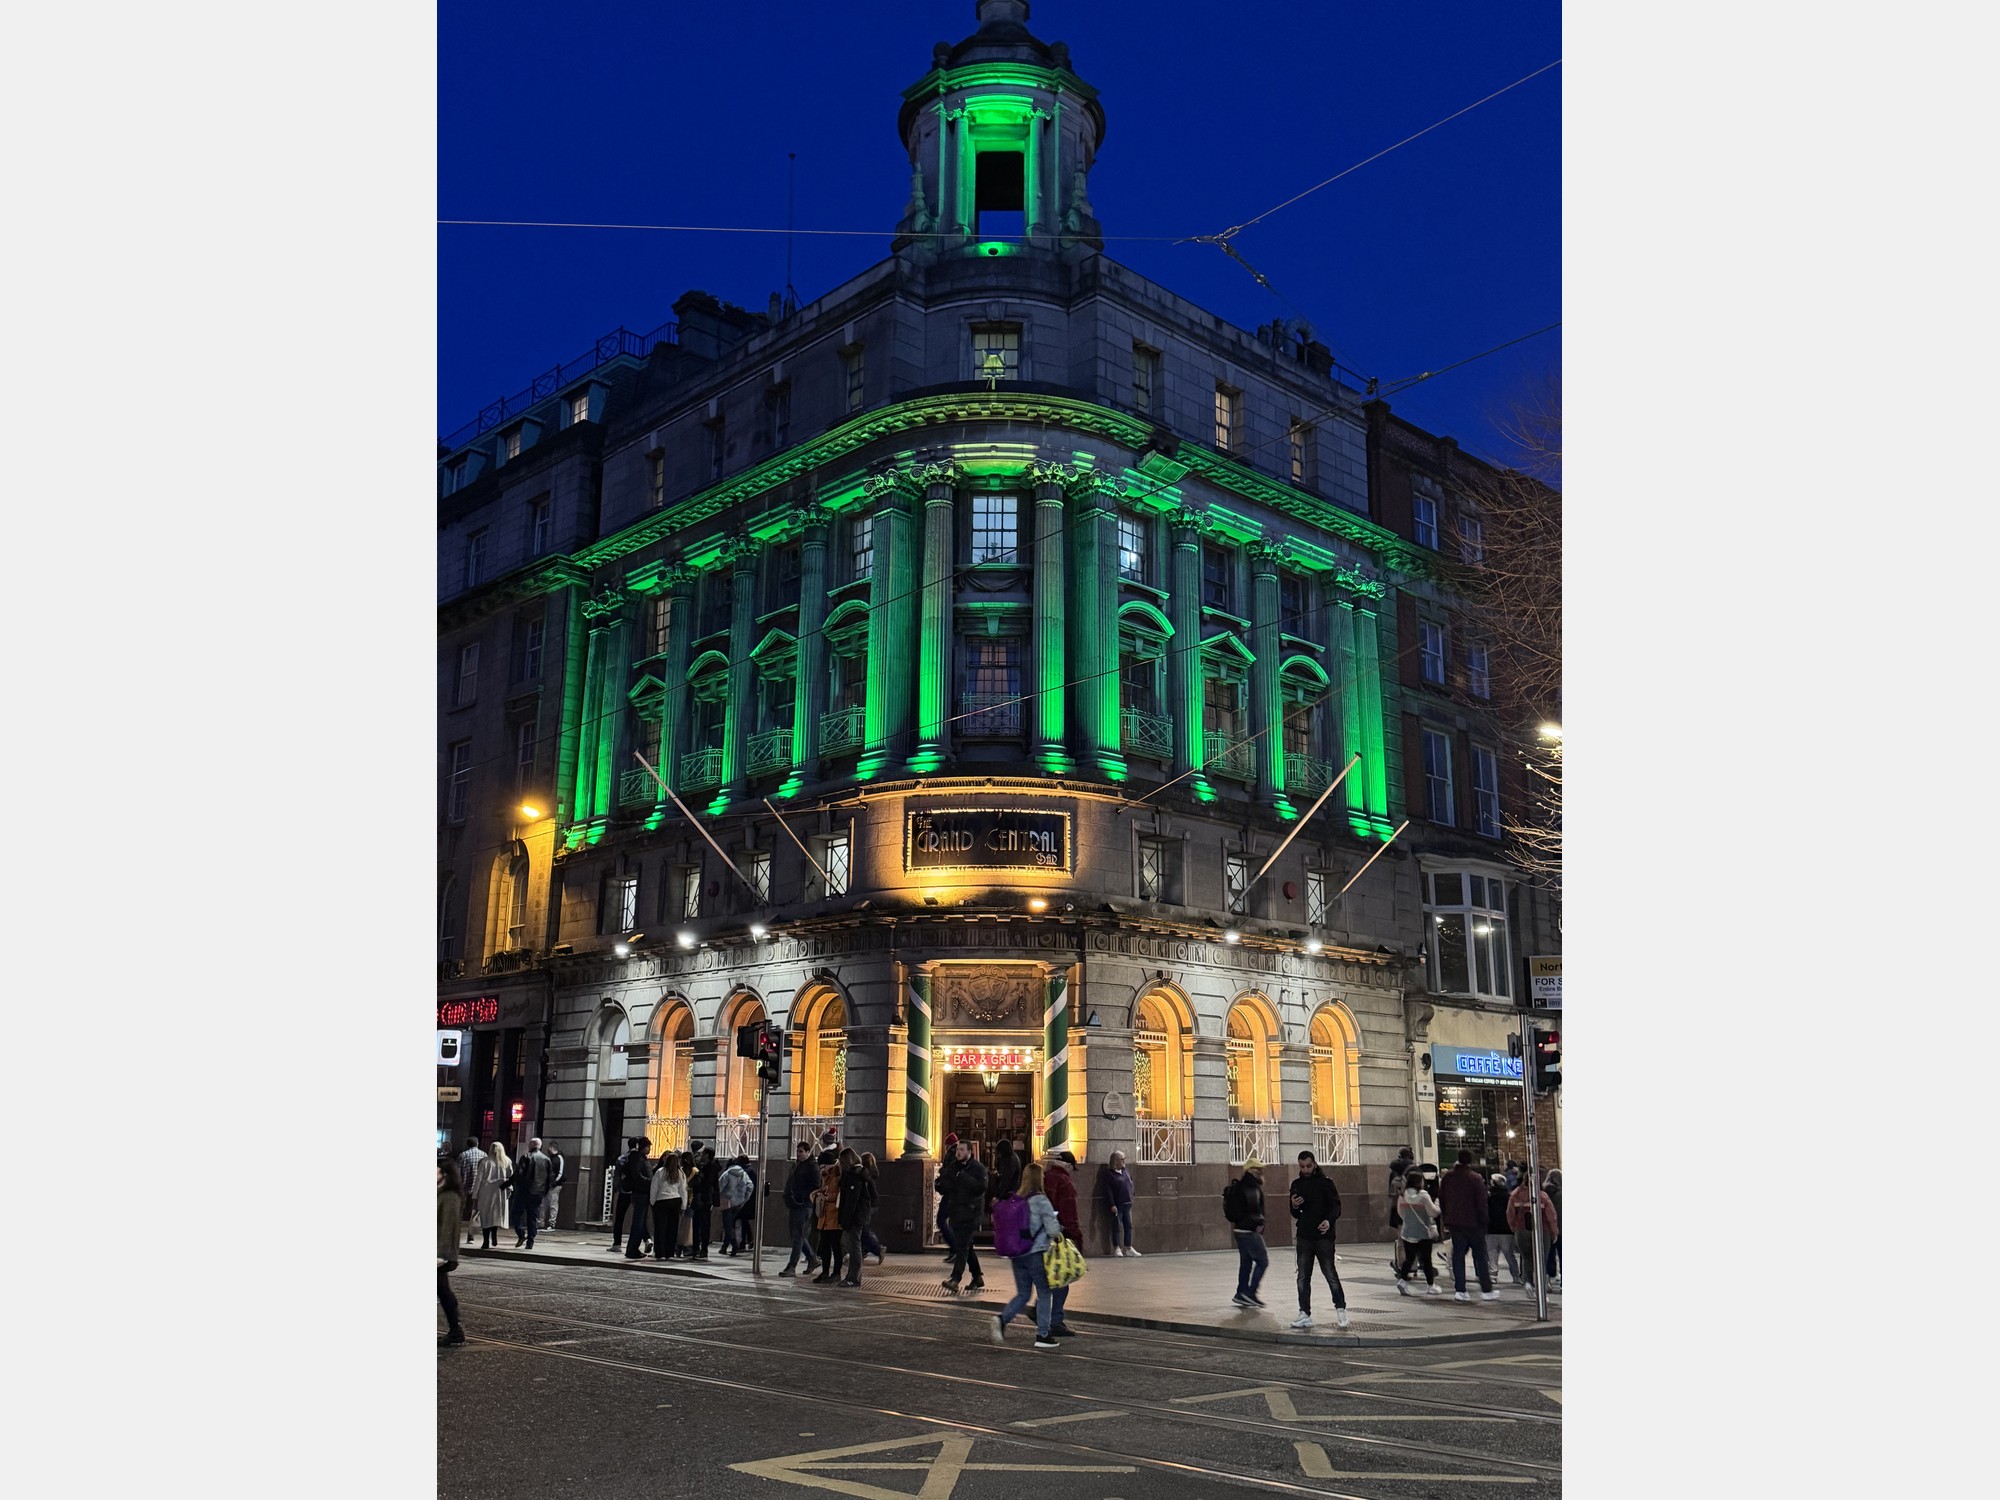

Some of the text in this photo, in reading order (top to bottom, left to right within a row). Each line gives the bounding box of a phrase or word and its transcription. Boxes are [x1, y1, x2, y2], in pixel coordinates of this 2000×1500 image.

[917, 816, 932, 828] THE
[917, 828, 1058, 852] GRAND CENTRAL
[1036, 853, 1058, 865] BAR
[1535, 977, 1556, 986] FOR
[953, 1054, 1022, 1065] BAR & GRILL
[1502, 1057, 1523, 1076] NE
